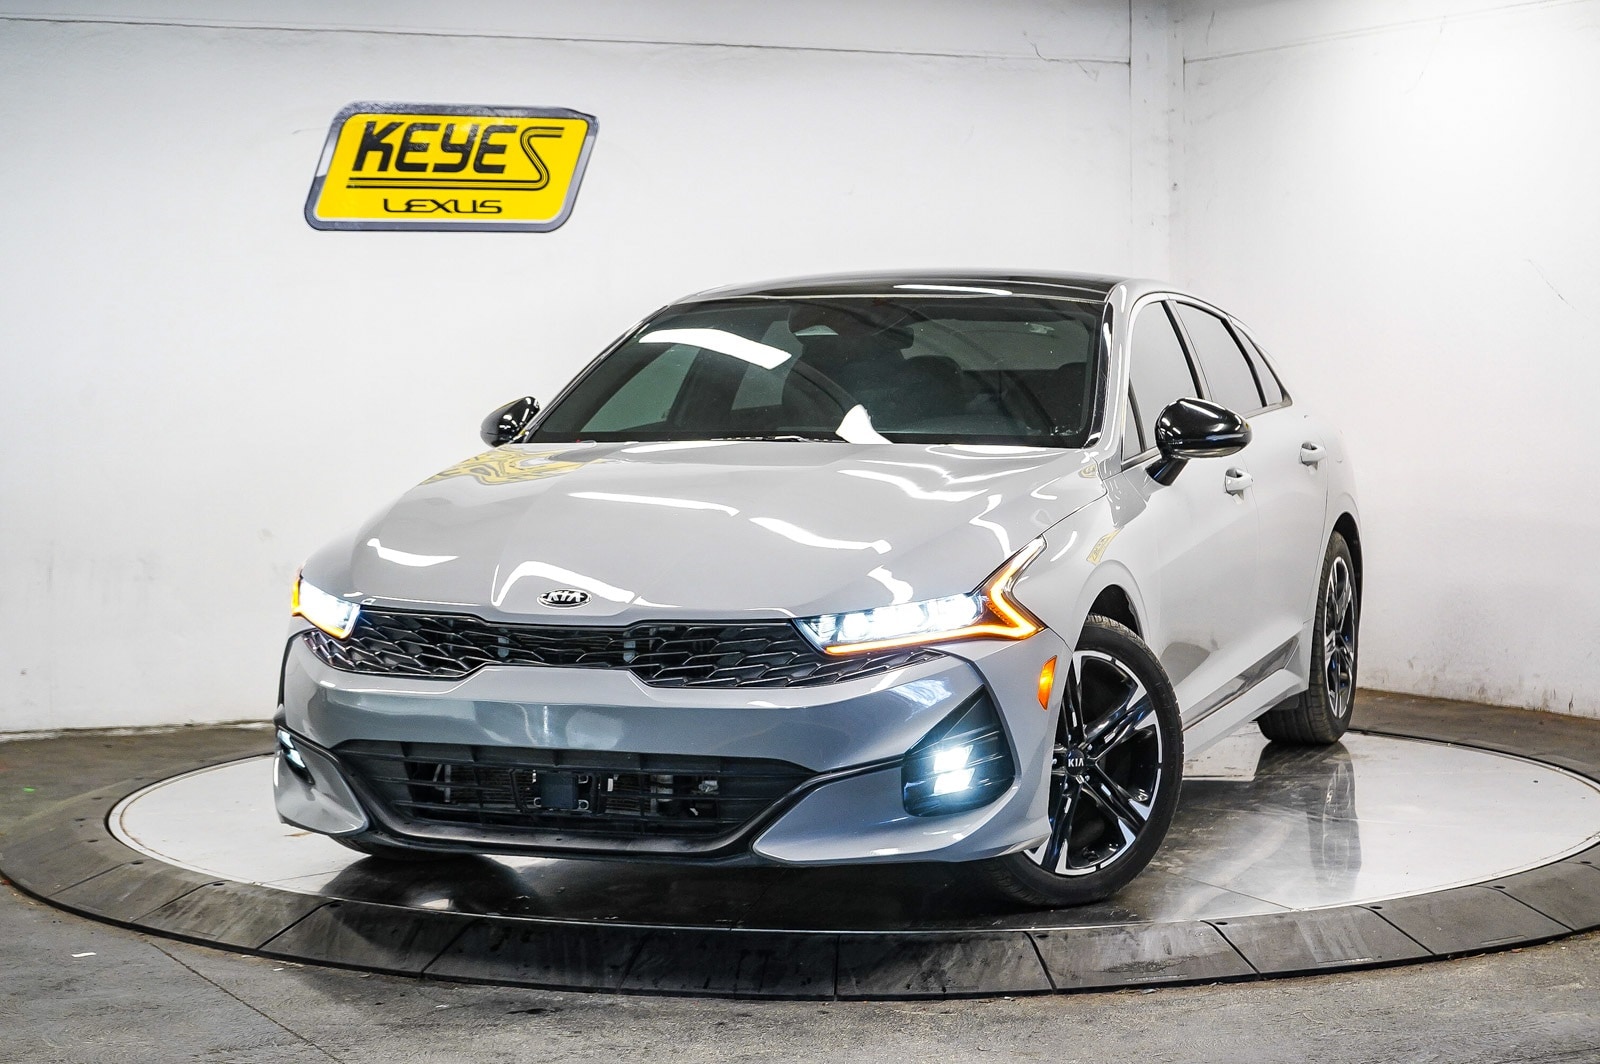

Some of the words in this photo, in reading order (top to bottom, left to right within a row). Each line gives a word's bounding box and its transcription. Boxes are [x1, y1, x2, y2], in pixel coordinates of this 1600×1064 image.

[349, 121, 565, 190] KEYES
[383, 198, 503, 214] LEXUS
[541, 590, 587, 604] KIA
[1068, 758, 1084, 767] KIA
